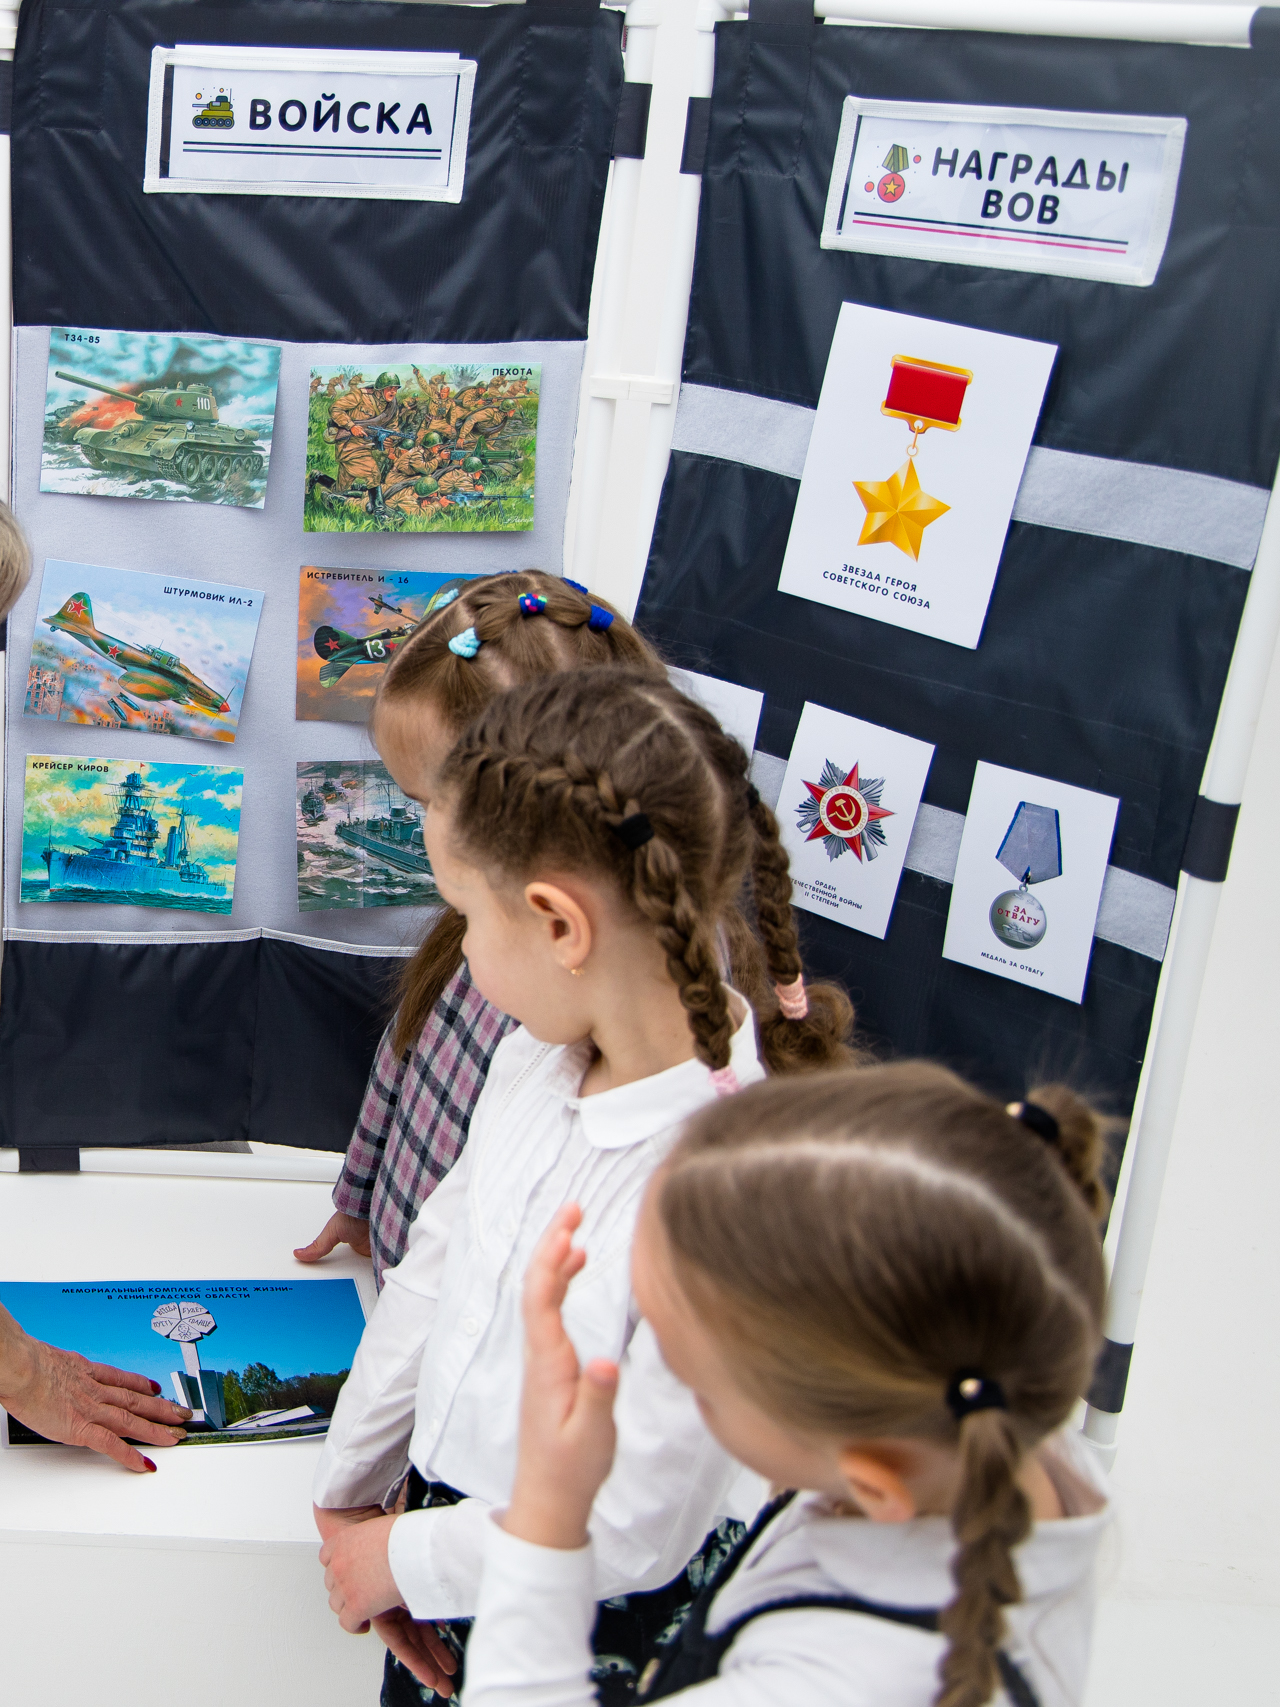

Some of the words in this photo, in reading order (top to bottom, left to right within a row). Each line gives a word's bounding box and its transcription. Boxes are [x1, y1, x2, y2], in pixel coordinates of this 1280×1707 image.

[248, 92, 434, 136] ВОЙСКА
[930, 146, 1130, 194] НАГРАДЫ
[980, 189, 1061, 225] ВОВ
[64, 333, 101, 344] Т34-85
[492, 367, 533, 376] ПЕХОТА
[196, 396, 210, 411] 110
[306, 571, 374, 582] ИСТРЕБИТЕЛЬ
[397, 576, 409, 584] 16
[841, 563, 882, 582] ЗВЕЗДА
[885, 576, 918, 593] ГЕРОЯ
[163, 586, 226, 602] ШТУРМОВИК
[228, 596, 254, 607] ИЛ-2
[822, 570, 889, 596] СОВЕТСКОГО
[893, 591, 931, 610] СОЮЗА
[365, 639, 386, 659] 13
[32, 762, 73, 771] КРЕЙСЕР
[77, 764, 109, 773] КИРОВ
[790, 878, 837, 900] ТЕЧЕСТВЕННОЙ
[838, 896, 863, 910] ВОЙНЫ
[814, 879, 837, 892] ОРДЕН
[811, 893, 839, 909] СТЕПЕНИ
[997, 907, 1041, 926] ОТВАГУ
[1013, 905, 1027, 915] ЗА
[980, 951, 1007, 964] МЕДАЛЬ
[1008, 960, 1018, 968] ЗА
[1019, 964, 1045, 977] ОТВАГУ
[61, 1286, 145, 1294] МЕМОРИАЛЬНЫЙ
[117, 1292, 201, 1300] ЛЕНИНГРАДСКОЙ
